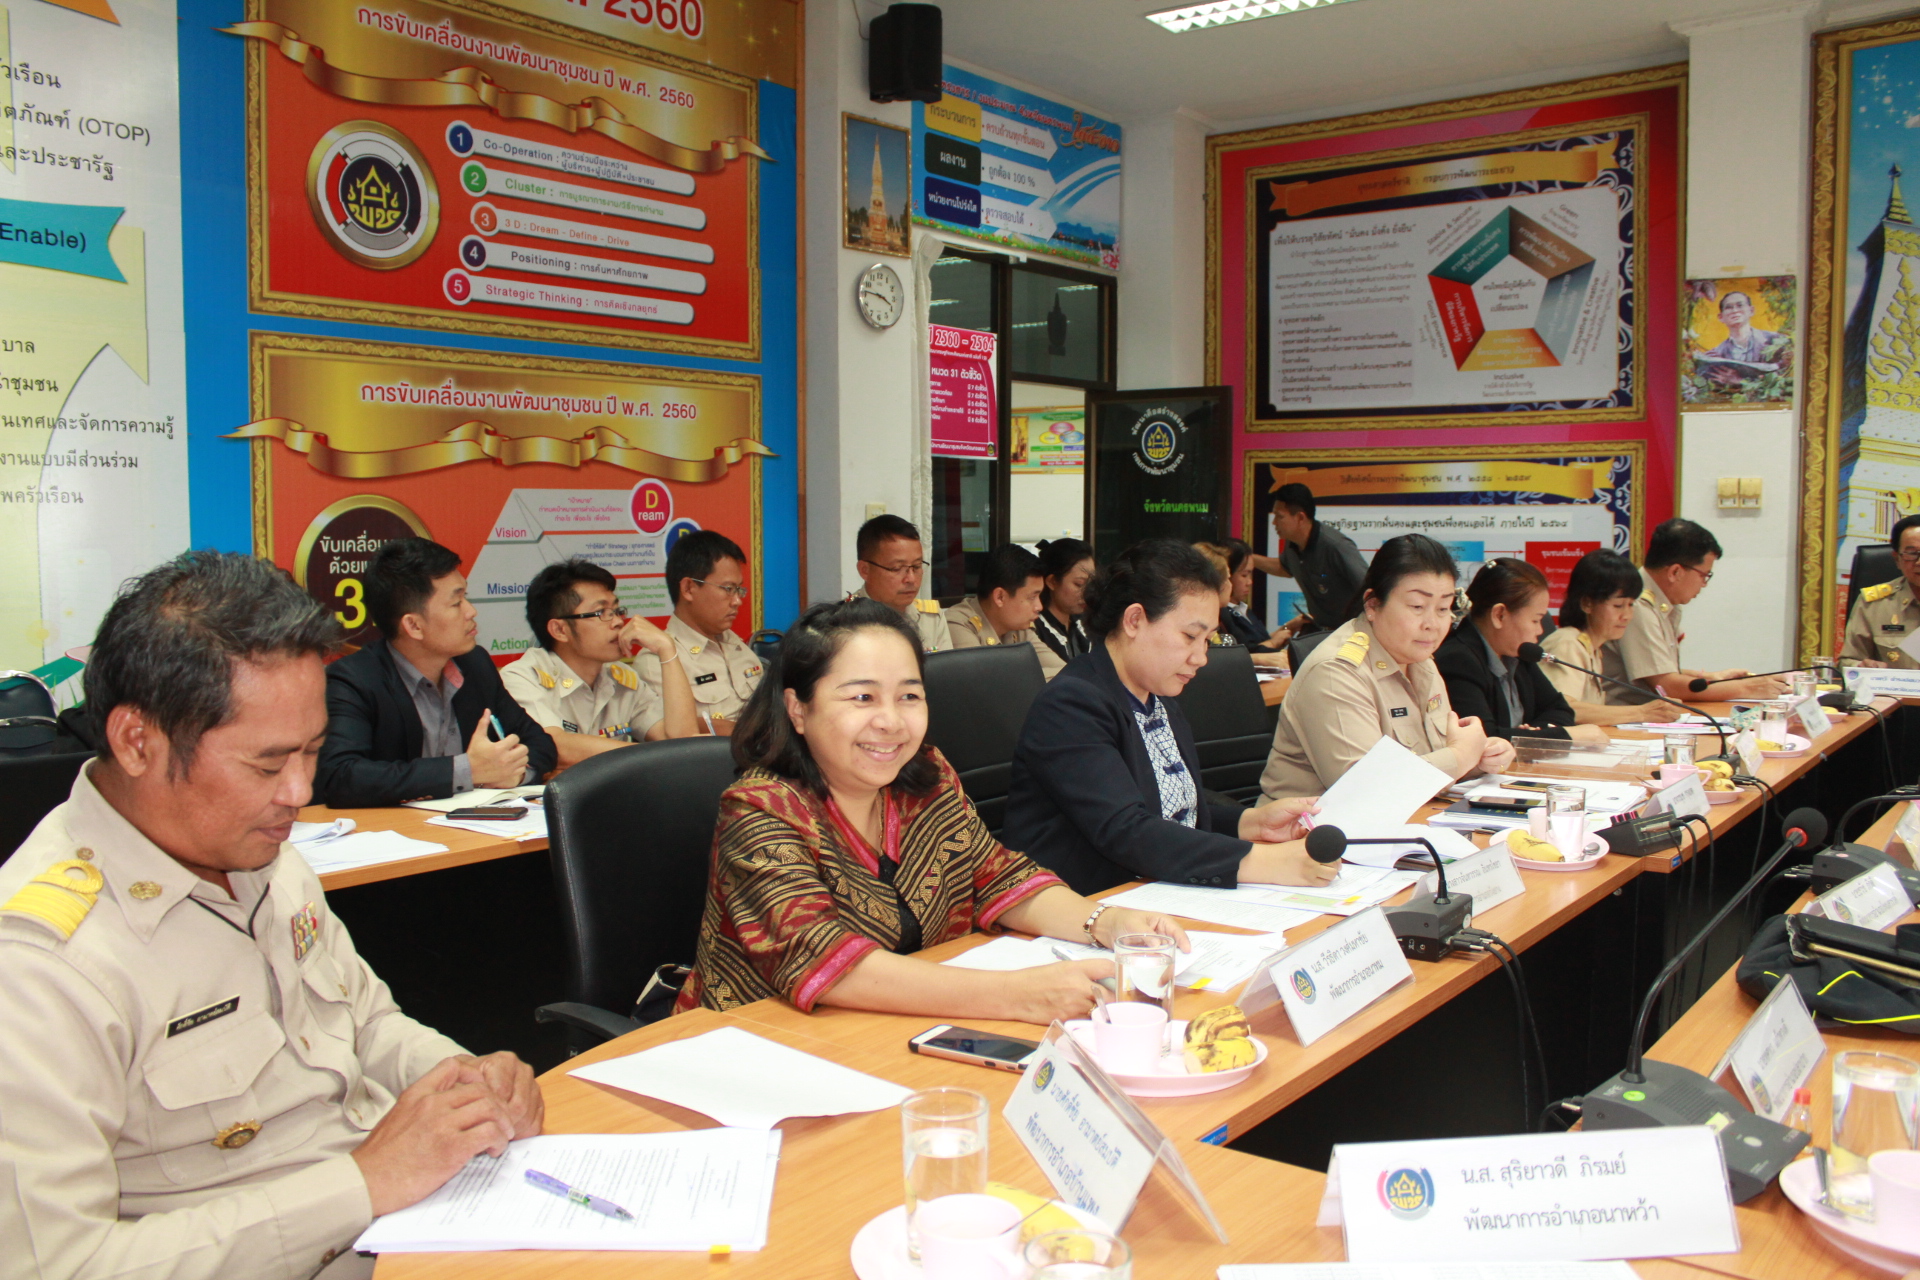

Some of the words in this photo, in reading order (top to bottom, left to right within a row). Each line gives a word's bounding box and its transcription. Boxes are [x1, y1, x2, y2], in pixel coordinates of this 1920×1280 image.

[358, 6, 599, 84] การขับเคลื่อนงานพัฒนาชุมชน
[603, 69, 614, 88] ปี
[618, 76, 651, 99] พ.ศ.
[658, 86, 695, 109] 2560
[0, 57, 62, 89] วเรือน
[78, 116, 151, 147] (OTOP)
[456, 132, 464, 147] 1
[483, 138, 553, 163] Co-Operation
[940, 152, 967, 168] ผลงาน
[470, 172, 479, 186] 2
[505, 177, 546, 196] Cluster
[1013, 172, 1026, 184] 100
[481, 213, 490, 226] 3
[1559, 204, 1578, 219] Green
[530, 222, 559, 236] Dream
[569, 228, 598, 242] Define
[607, 235, 630, 247] Drive
[469, 246, 478, 259] 4
[511, 252, 571, 271] Positioning
[454, 280, 462, 293] 5
[485, 284, 535, 301] Strategic
[540, 291, 582, 307] Thinking
[935, 329, 960, 348] 2560
[970, 334, 994, 352] 2564
[951, 369, 958, 377] 31
[361, 379, 602, 420] การขับเคลื่อนงานพัฒนาชุมชน
[606, 395, 617, 414] ปี
[622, 400, 654, 417] พ.ศ.
[662, 402, 697, 419] 2560
[645, 490, 659, 508] D
[638, 510, 664, 521] ream
[495, 526, 527, 538] Vision
[320, 530, 382, 553] ขับเคลื่อ
[487, 582, 530, 595] Mission
[335, 578, 367, 629] 3
[490, 638, 529, 650] Action
[1461, 1167, 1495, 1183] น.ส.
[1500, 1156, 1567, 1188] สุริยาวดี
[1579, 1151, 1626, 1177] ภิรมย์
[1464, 1197, 1660, 1231] พัฒนาการอำเภอนาหว้า
